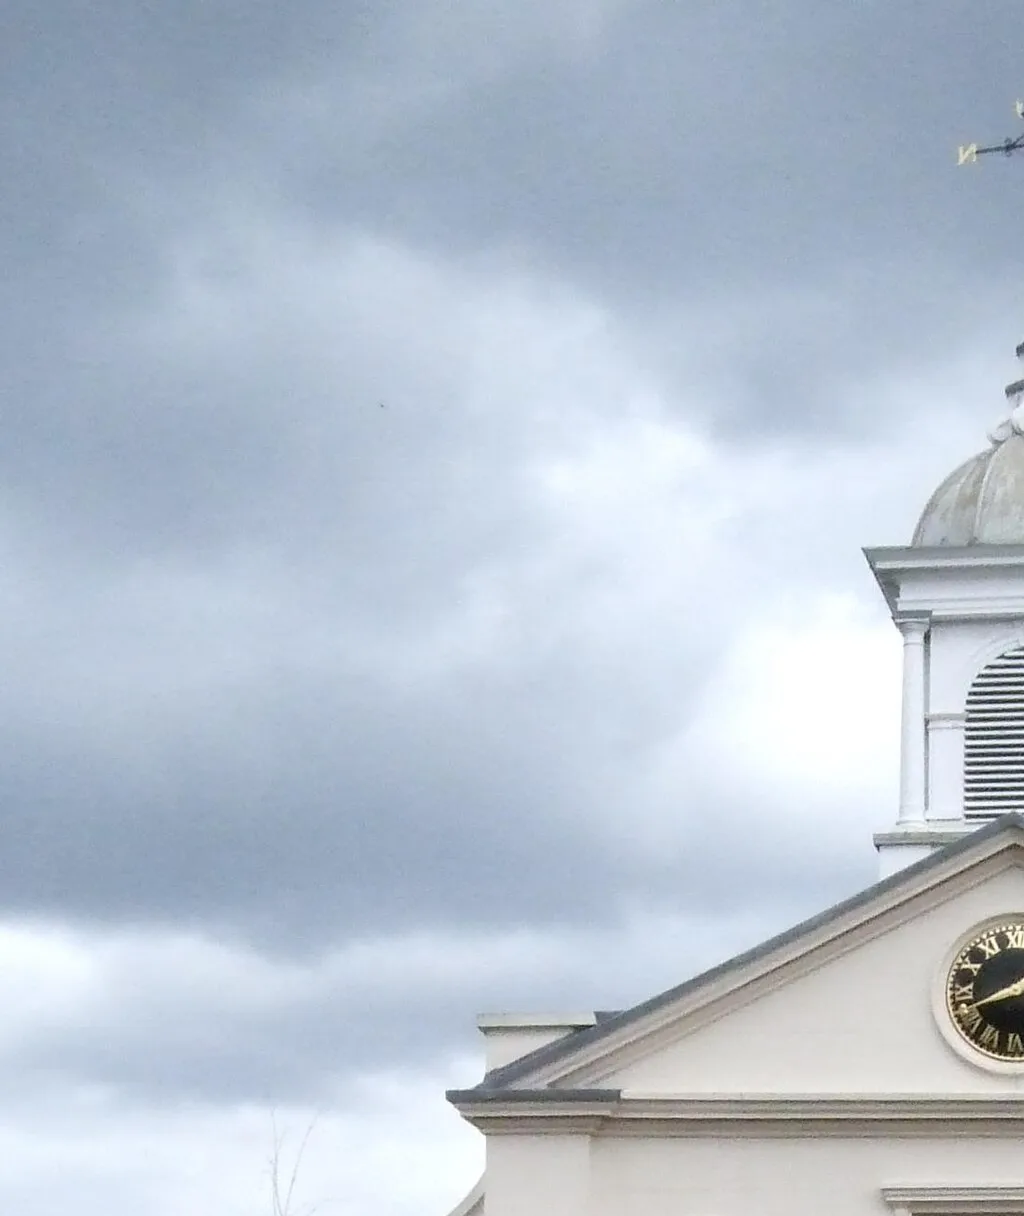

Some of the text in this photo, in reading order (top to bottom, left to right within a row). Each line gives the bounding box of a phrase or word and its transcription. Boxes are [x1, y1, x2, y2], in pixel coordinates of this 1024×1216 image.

[976, 936, 1002, 960] XI
[960, 956, 983, 977] X
[954, 982, 974, 1001] IX
[1007, 1032, 1024, 1052] VI
